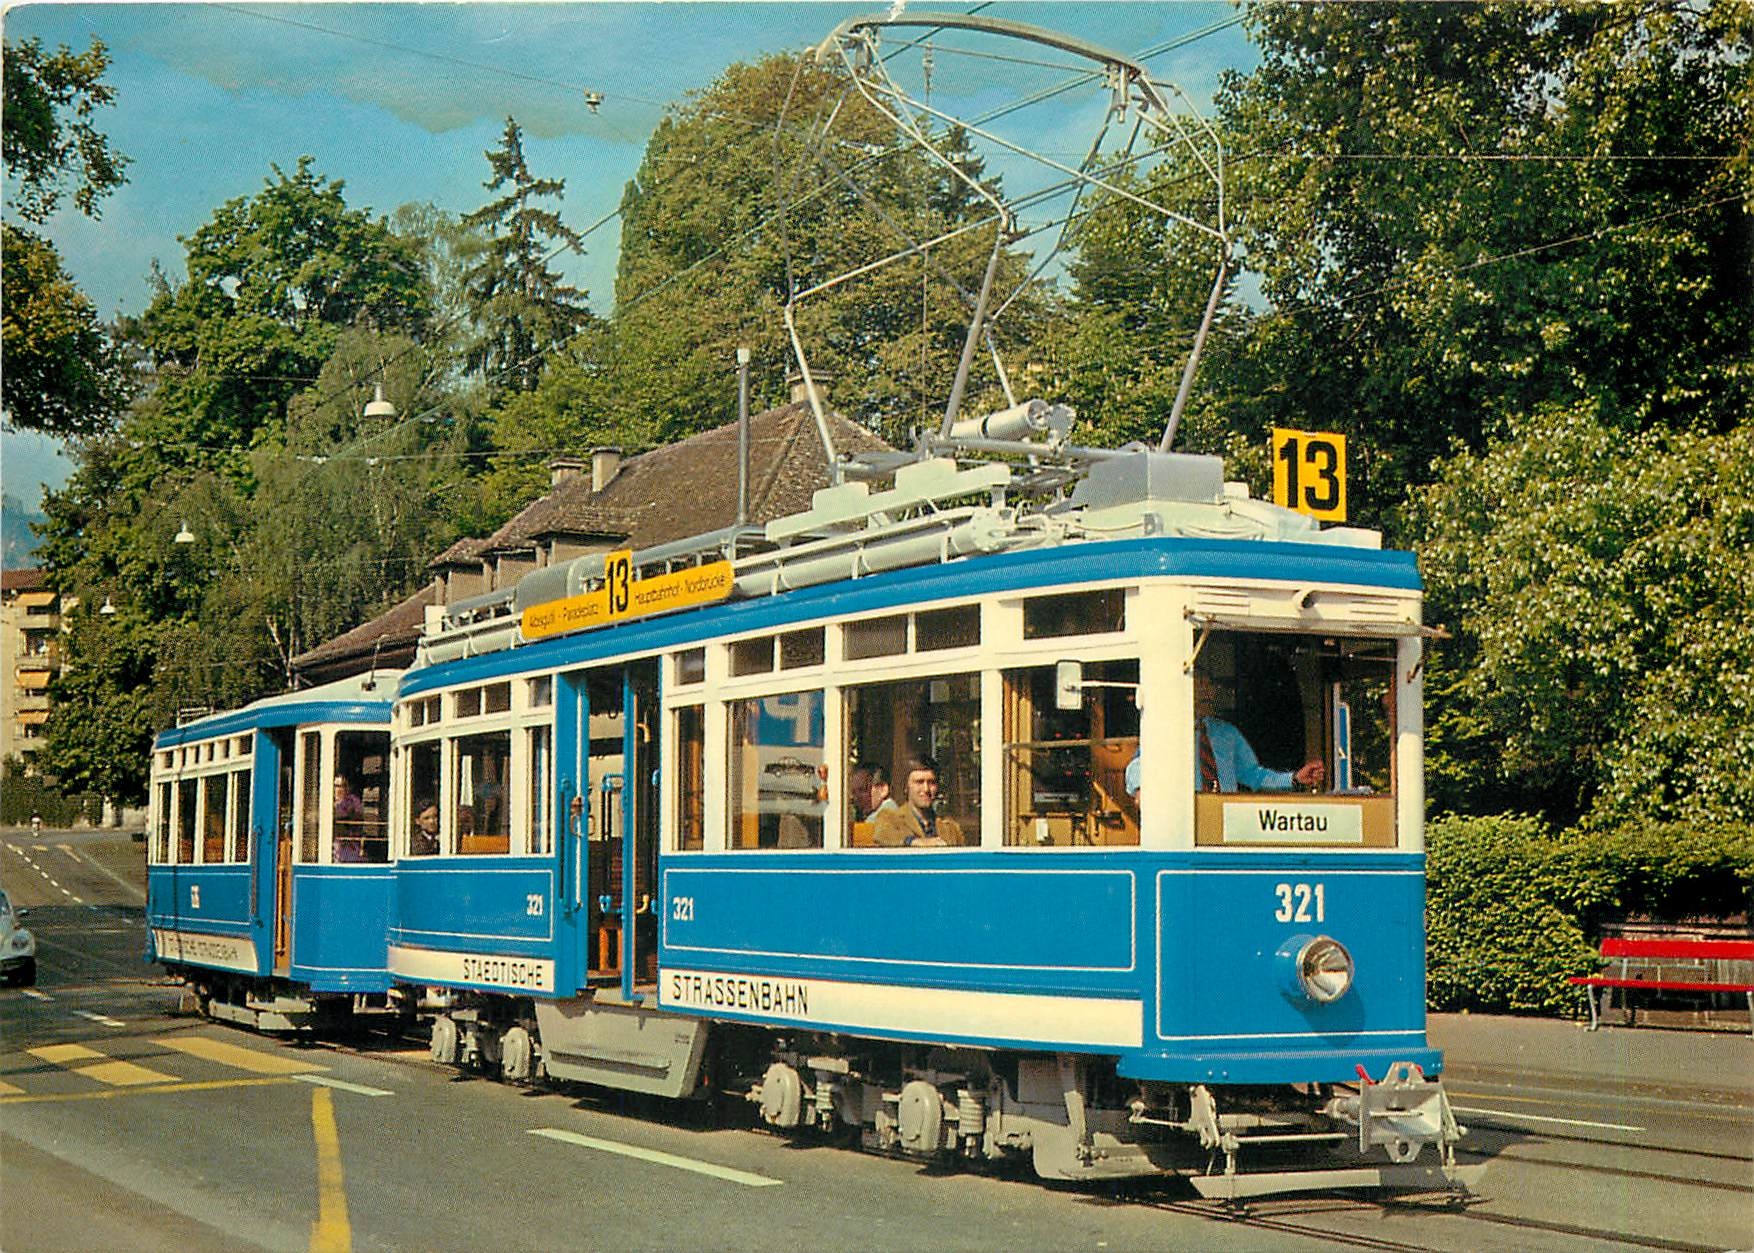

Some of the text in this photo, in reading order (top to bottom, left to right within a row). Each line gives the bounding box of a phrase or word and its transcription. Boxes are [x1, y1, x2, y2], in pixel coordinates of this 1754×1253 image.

[1279, 437, 1340, 511] 13
[606, 557, 630, 615] 13
[1258, 809, 1328, 832] Wartau
[525, 894, 544, 916] 321
[672, 896, 696, 921] 321
[1274, 883, 1326, 923] 321
[463, 958, 809, 1015] STAEDTISCHE STRASSENBAHN
